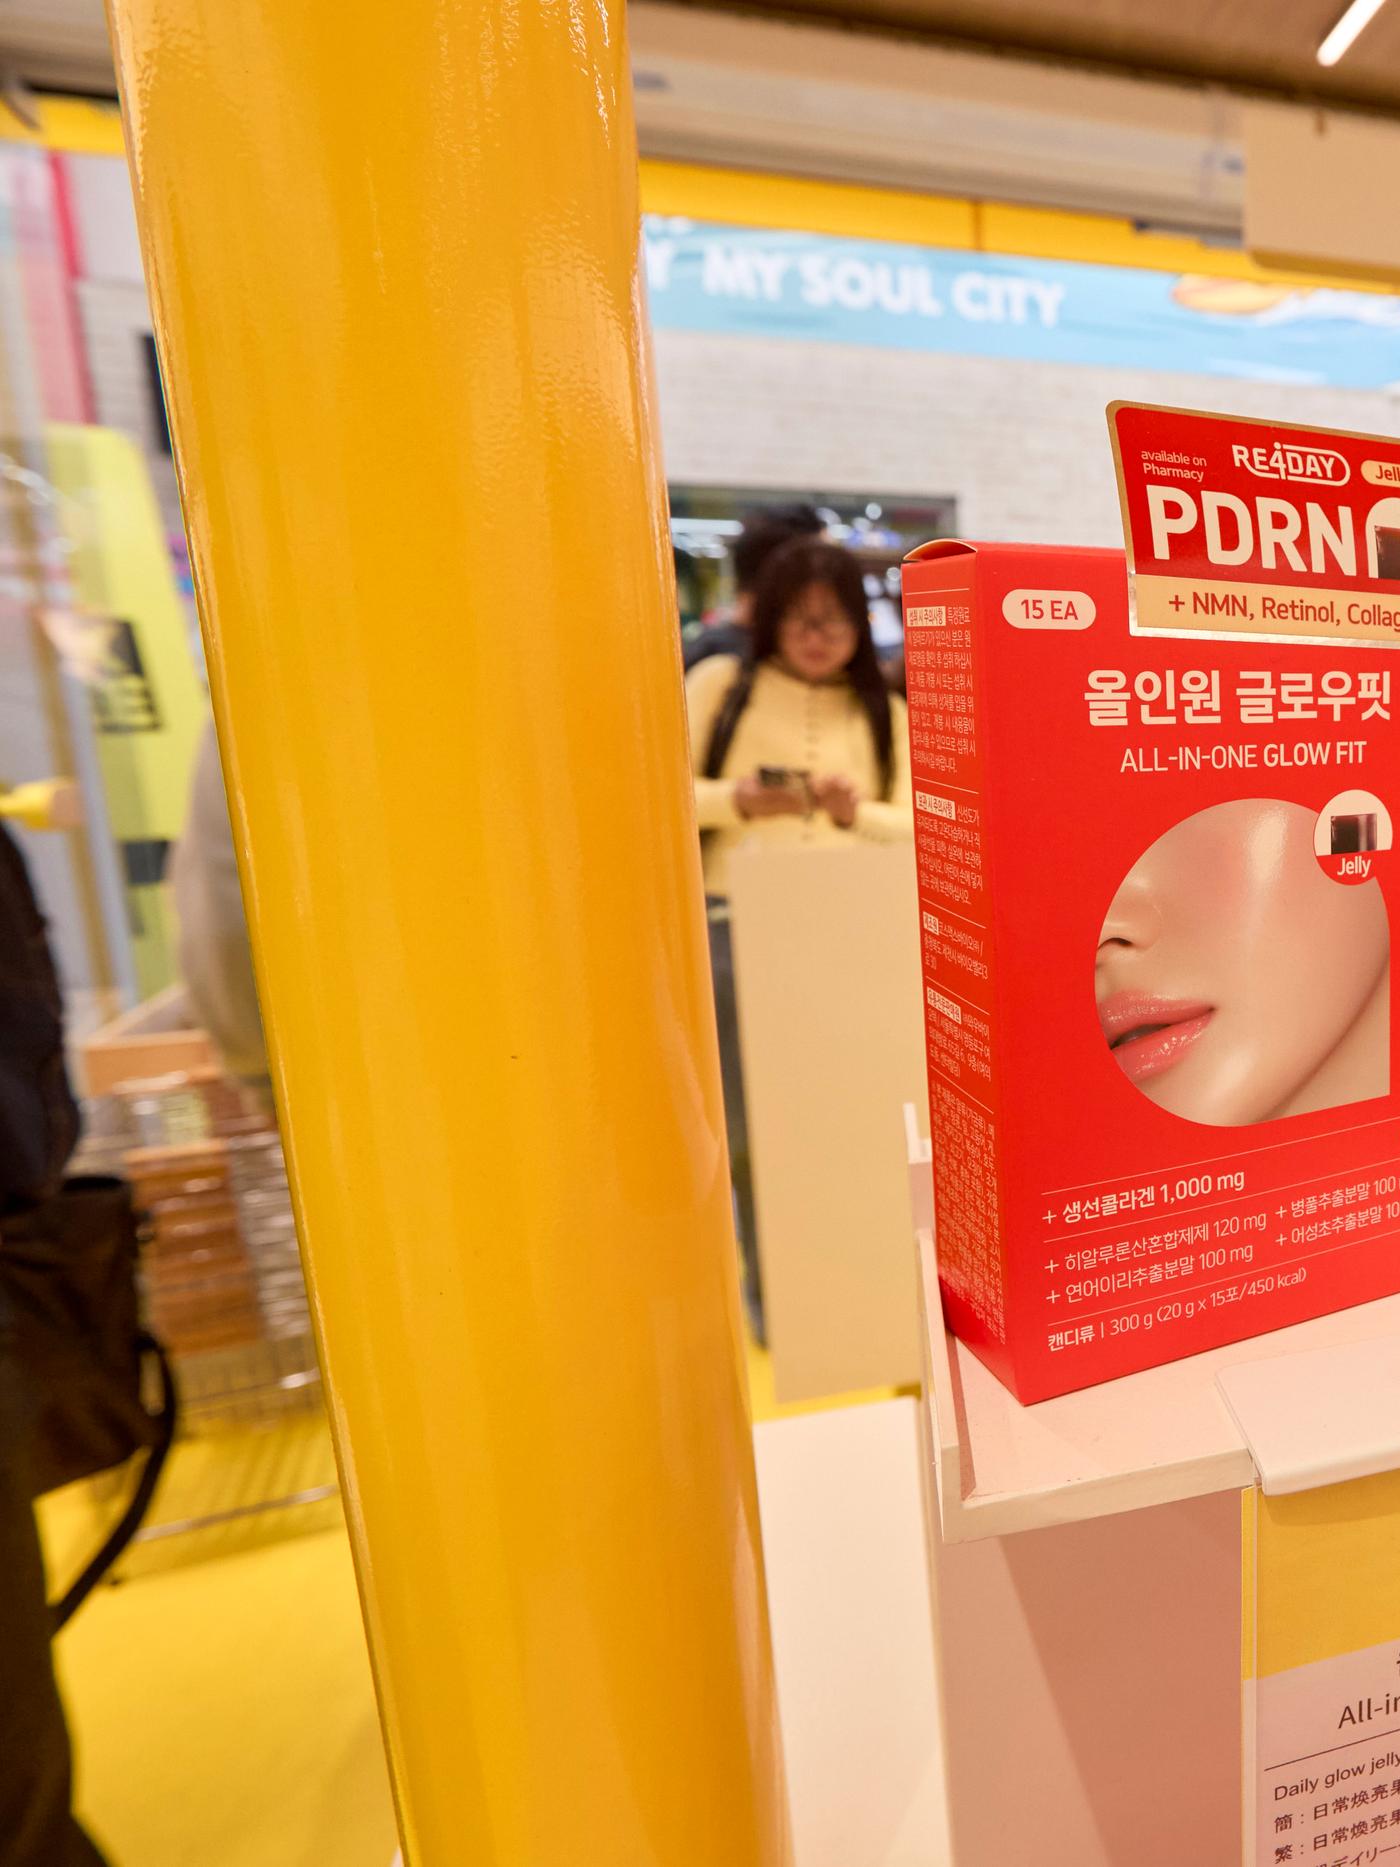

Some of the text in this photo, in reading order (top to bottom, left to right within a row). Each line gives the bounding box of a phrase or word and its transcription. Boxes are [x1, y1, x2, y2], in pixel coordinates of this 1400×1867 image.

[702, 243, 790, 301] MY
[799, 252, 943, 319] SOUL
[950, 273, 1066, 327] CITY
[1141, 450, 1207, 467] available on
[1143, 463, 1204, 482] Pharmacy
[1146, 484, 1357, 577] PDRN
[1021, 599, 1079, 621] 15 EA
[1193, 591, 1255, 621] NMN,
[1262, 597, 1340, 626] Retinol,
[1084, 669, 1391, 727] 올인원 글로우핏
[1120, 741, 1367, 773] ALL-IN-ONE GLOW FIT
[1337, 855, 1372, 878] Jelly
[1062, 1171, 1245, 1224] 생선콜라겐 1,000 mg
[1291, 1182, 1370, 1218] 병풀추출분말
[1374, 1176, 1396, 1195] 100
[1065, 1213, 1267, 1271] 히알루론산혼합제제 120 mg
[1291, 1205, 1382, 1244] 어성초추출분말
[1065, 1245, 1254, 1304] 연어이리추출분말 100 mg
[1048, 1267, 1307, 1352] 캔디류 300 g (20 g x 15포/450 kcal)
[1274, 1778, 1319, 1802] Daily
[1324, 1762, 1366, 1789] glow
